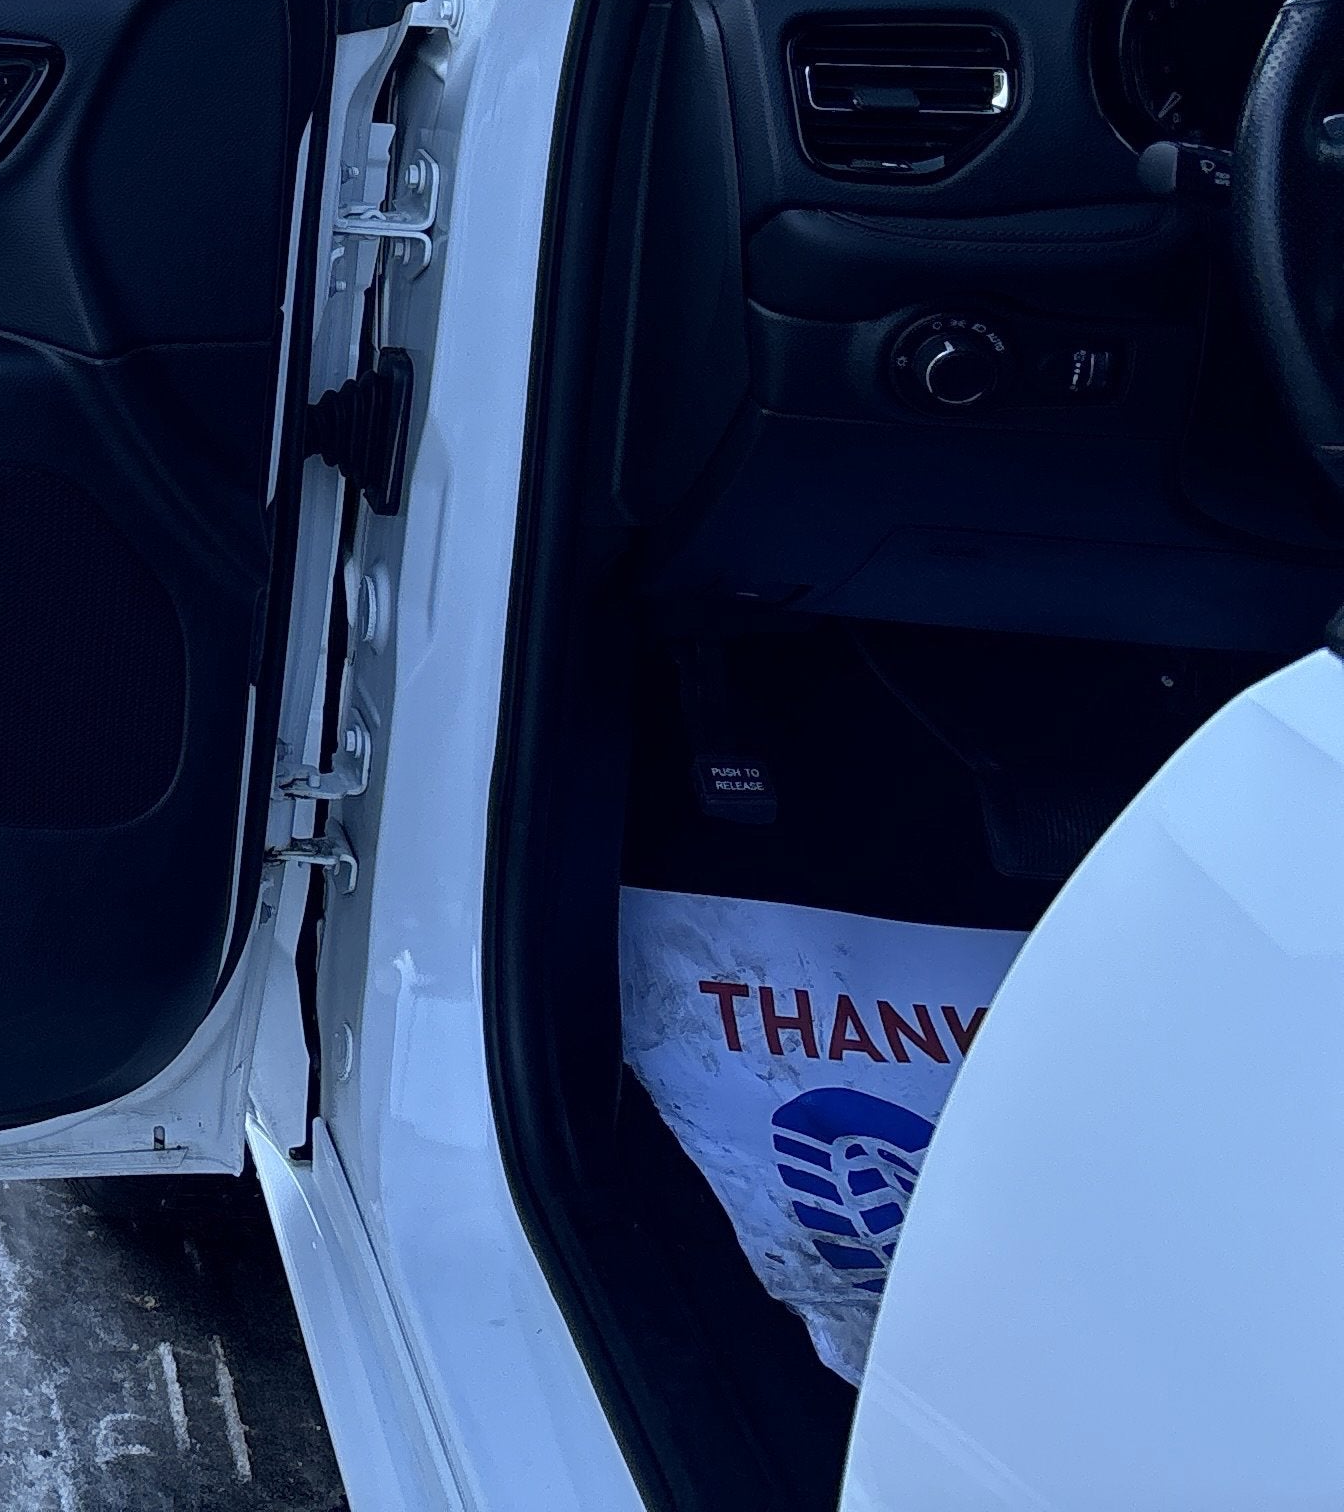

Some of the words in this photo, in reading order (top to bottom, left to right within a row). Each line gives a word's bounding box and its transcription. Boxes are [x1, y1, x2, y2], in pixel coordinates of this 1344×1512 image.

[711, 768, 742, 777] PUSH
[744, 768, 760, 777] TO
[715, 781, 765, 791] RELEASE
